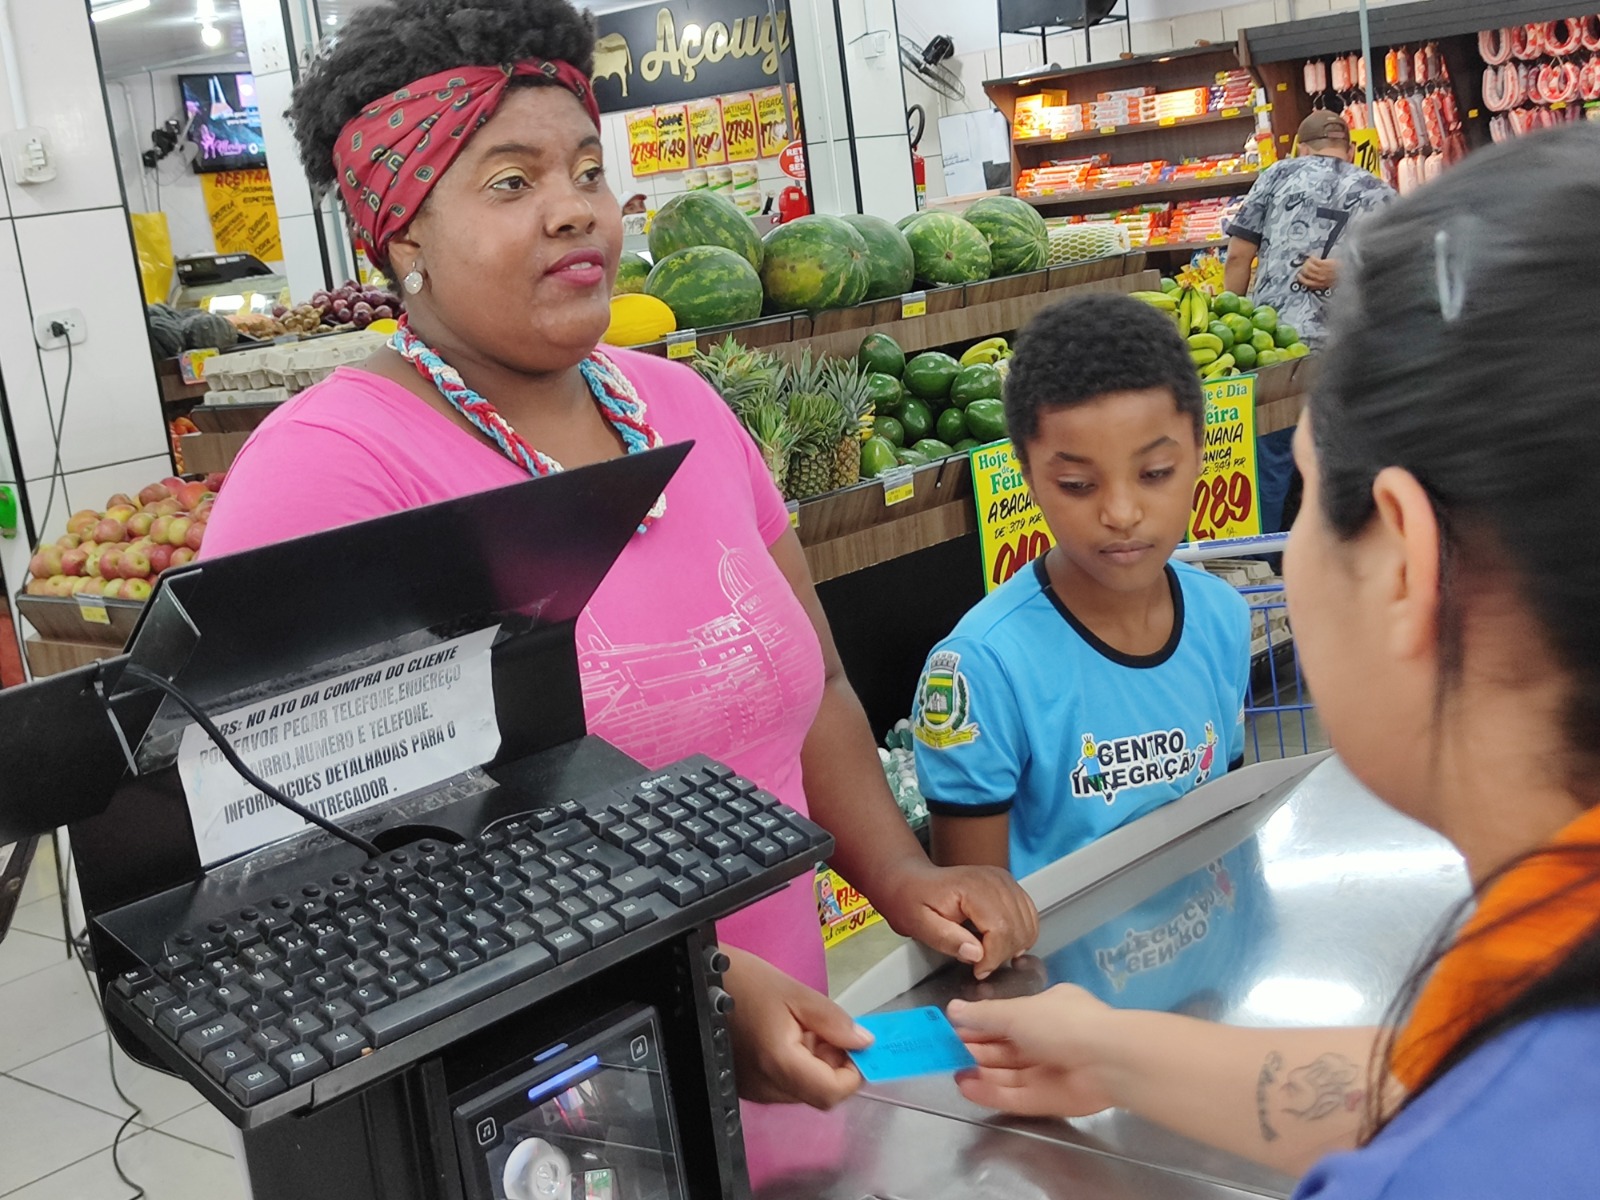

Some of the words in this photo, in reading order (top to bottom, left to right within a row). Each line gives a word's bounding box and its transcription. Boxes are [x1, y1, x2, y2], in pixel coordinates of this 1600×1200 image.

[1226, 383, 1247, 398] Dia
[978, 450, 1008, 470] Hoje
[988, 492, 1037, 523] ABACA
[1191, 471, 1252, 540] 2,89
[246, 709, 266, 729] NO
[269, 698, 298, 720] ATO
[300, 691, 320, 709] DA
[323, 669, 383, 701] COMPRA
[385, 662, 405, 681] DO
[407, 645, 459, 674] CLIENTE
[357, 725, 366, 744] E
[325, 738, 409, 785] DETALHADAS
[411, 724, 445, 753] PARA
[447, 720, 456, 739] O
